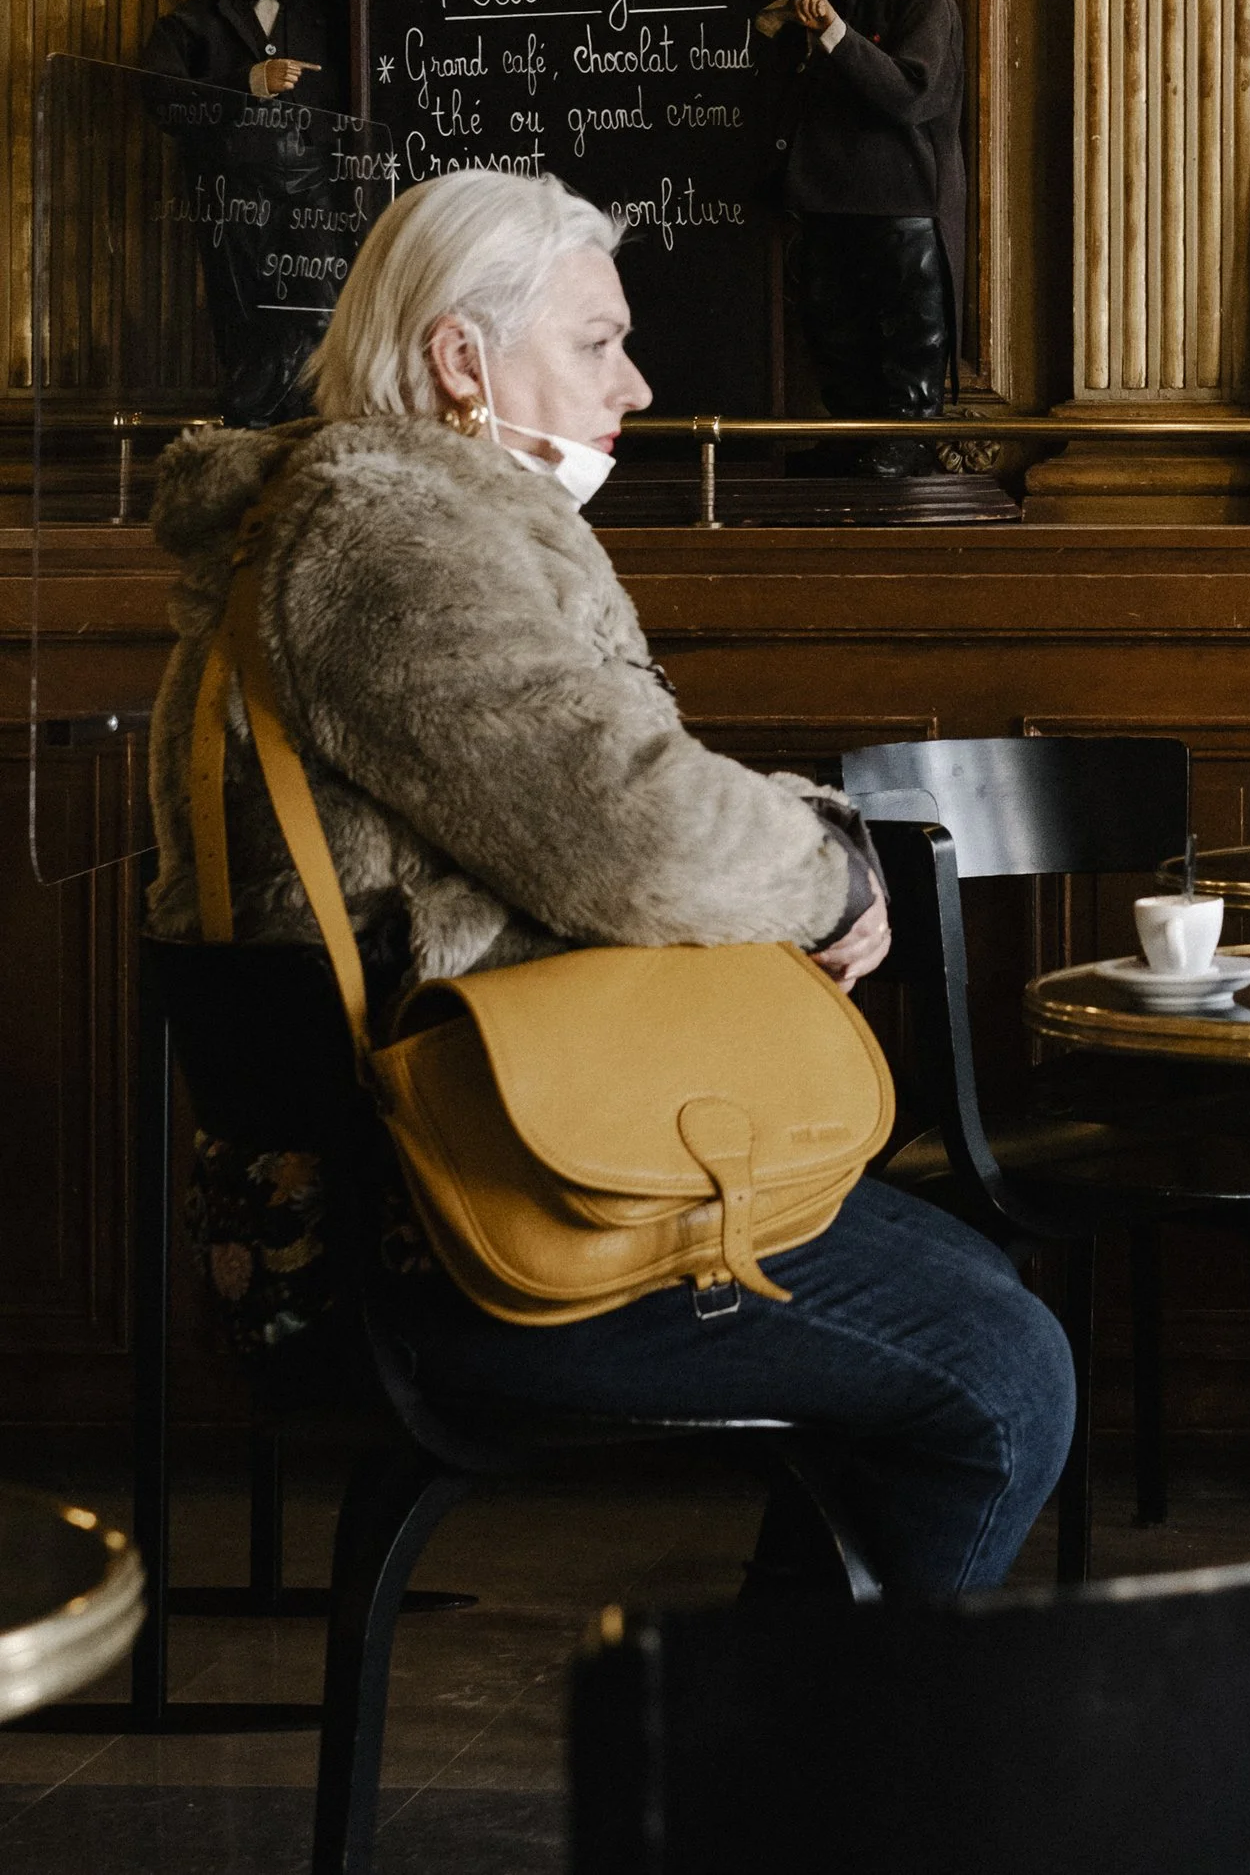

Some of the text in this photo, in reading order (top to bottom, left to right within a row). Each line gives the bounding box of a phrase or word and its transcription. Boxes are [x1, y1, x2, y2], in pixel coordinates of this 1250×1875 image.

[404, 27, 488, 110] Grand
[573, 24, 678, 75] chocolat
[431, 88, 483, 136] thé
[509, 112, 545, 134] ou
[567, 86, 653, 158] grand
[609, 177, 745, 251] confiture
